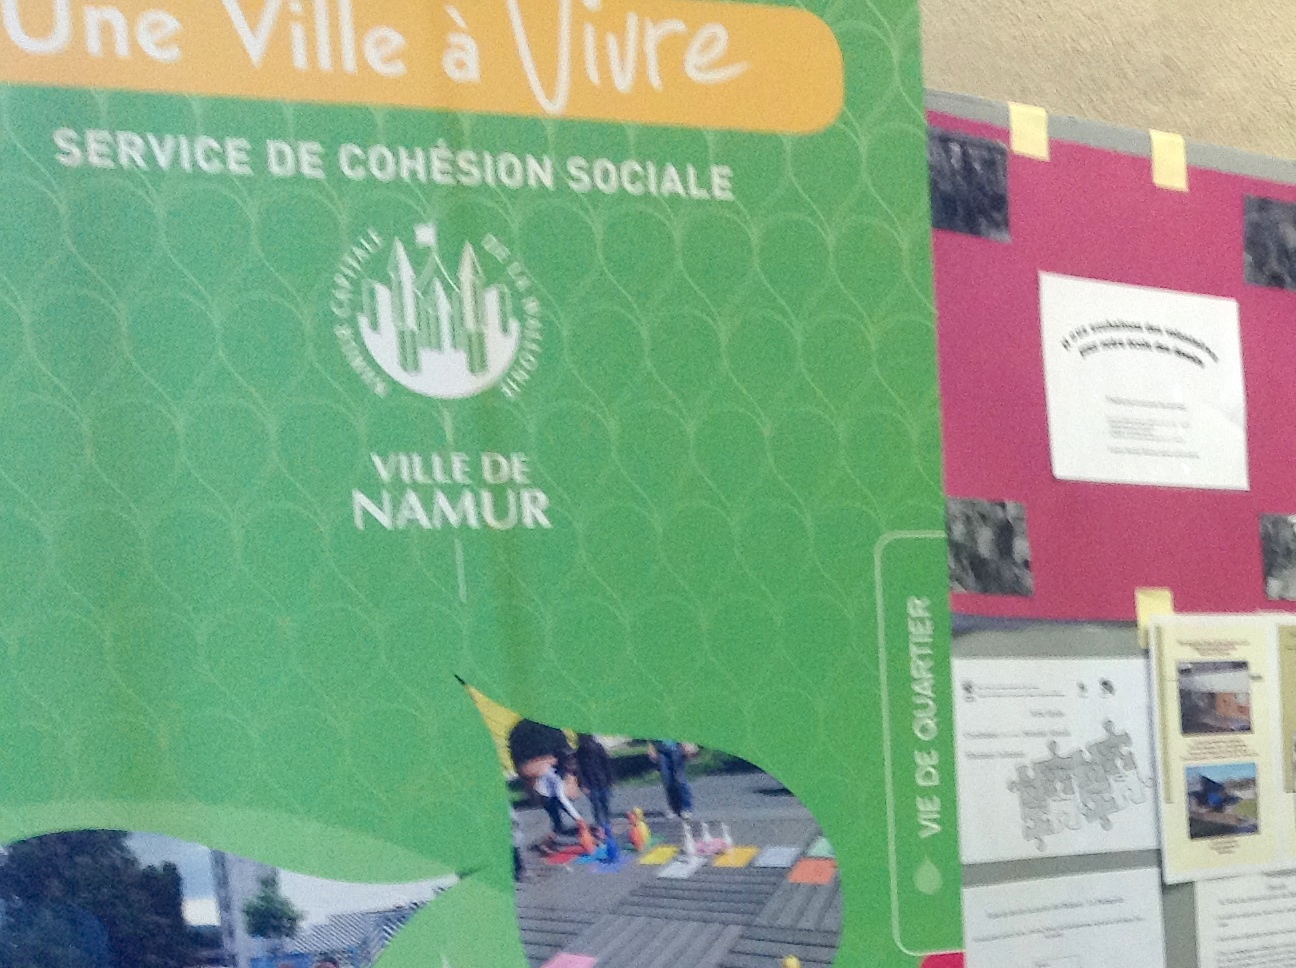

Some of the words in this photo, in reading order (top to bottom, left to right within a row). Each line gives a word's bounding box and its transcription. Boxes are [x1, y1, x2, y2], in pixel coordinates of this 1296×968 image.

[2, 0, 184, 62] Une
[216, 0, 410, 77] Ville
[440, 4, 482, 84] à
[512, 0, 753, 116] Vivre
[52, 127, 254, 178] SERVICE
[267, 138, 325, 180] DE
[338, 138, 556, 192] COHÉSION
[565, 154, 736, 202] SOCIALE
[370, 452, 473, 485] VILLE
[481, 452, 531, 485] DE
[352, 488, 553, 531] NAMUR
[906, 595, 938, 742] QUARTIER
[914, 748, 940, 787] DE
[917, 794, 942, 840] VIE
